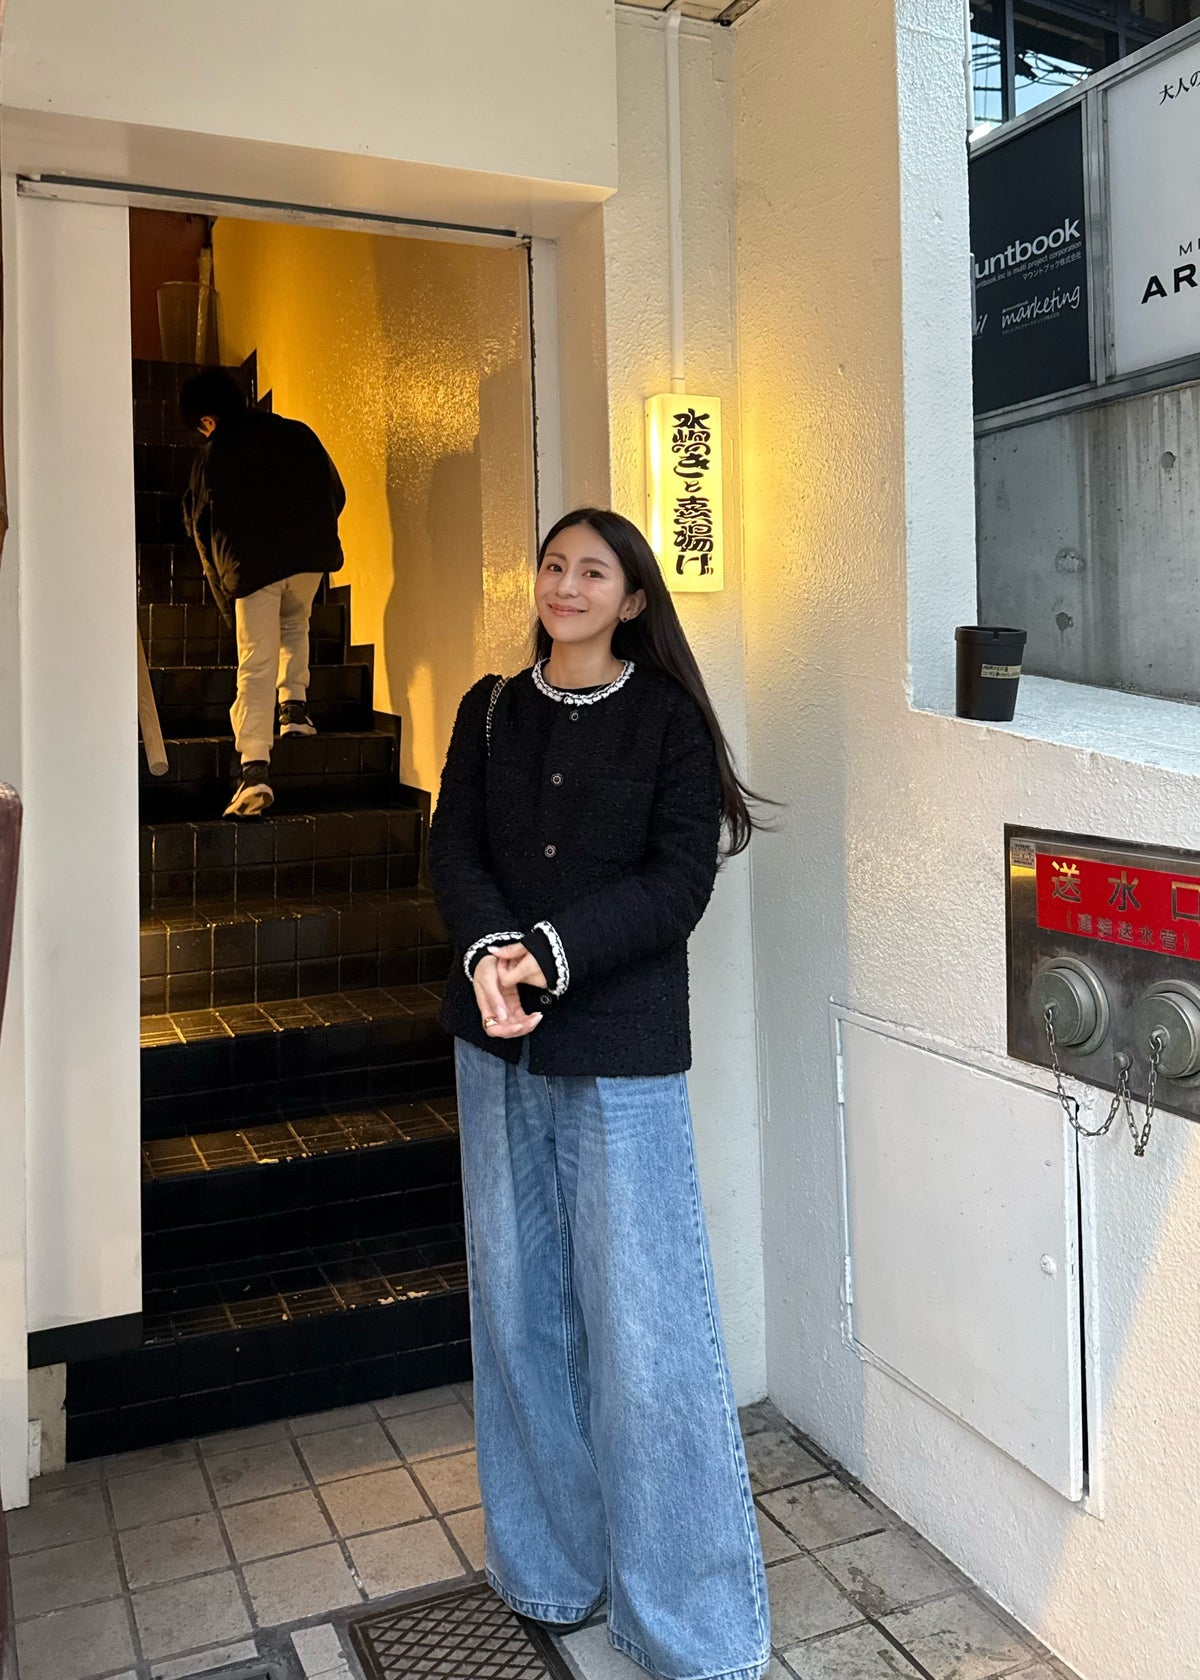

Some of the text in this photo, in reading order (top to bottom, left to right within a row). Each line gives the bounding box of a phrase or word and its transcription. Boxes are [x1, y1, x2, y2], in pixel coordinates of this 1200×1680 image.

[975, 218, 1080, 279] untbook
[1028, 255, 1048, 269] project
[1049, 241, 1082, 260] corporation
[1179, 237, 1200, 257] M
[1141, 263, 1199, 305] AR
[1001, 285, 1081, 329] marketing
[671, 407, 715, 577] 水炊きと素揚げ
[1051, 860, 1200, 924] 送水口
